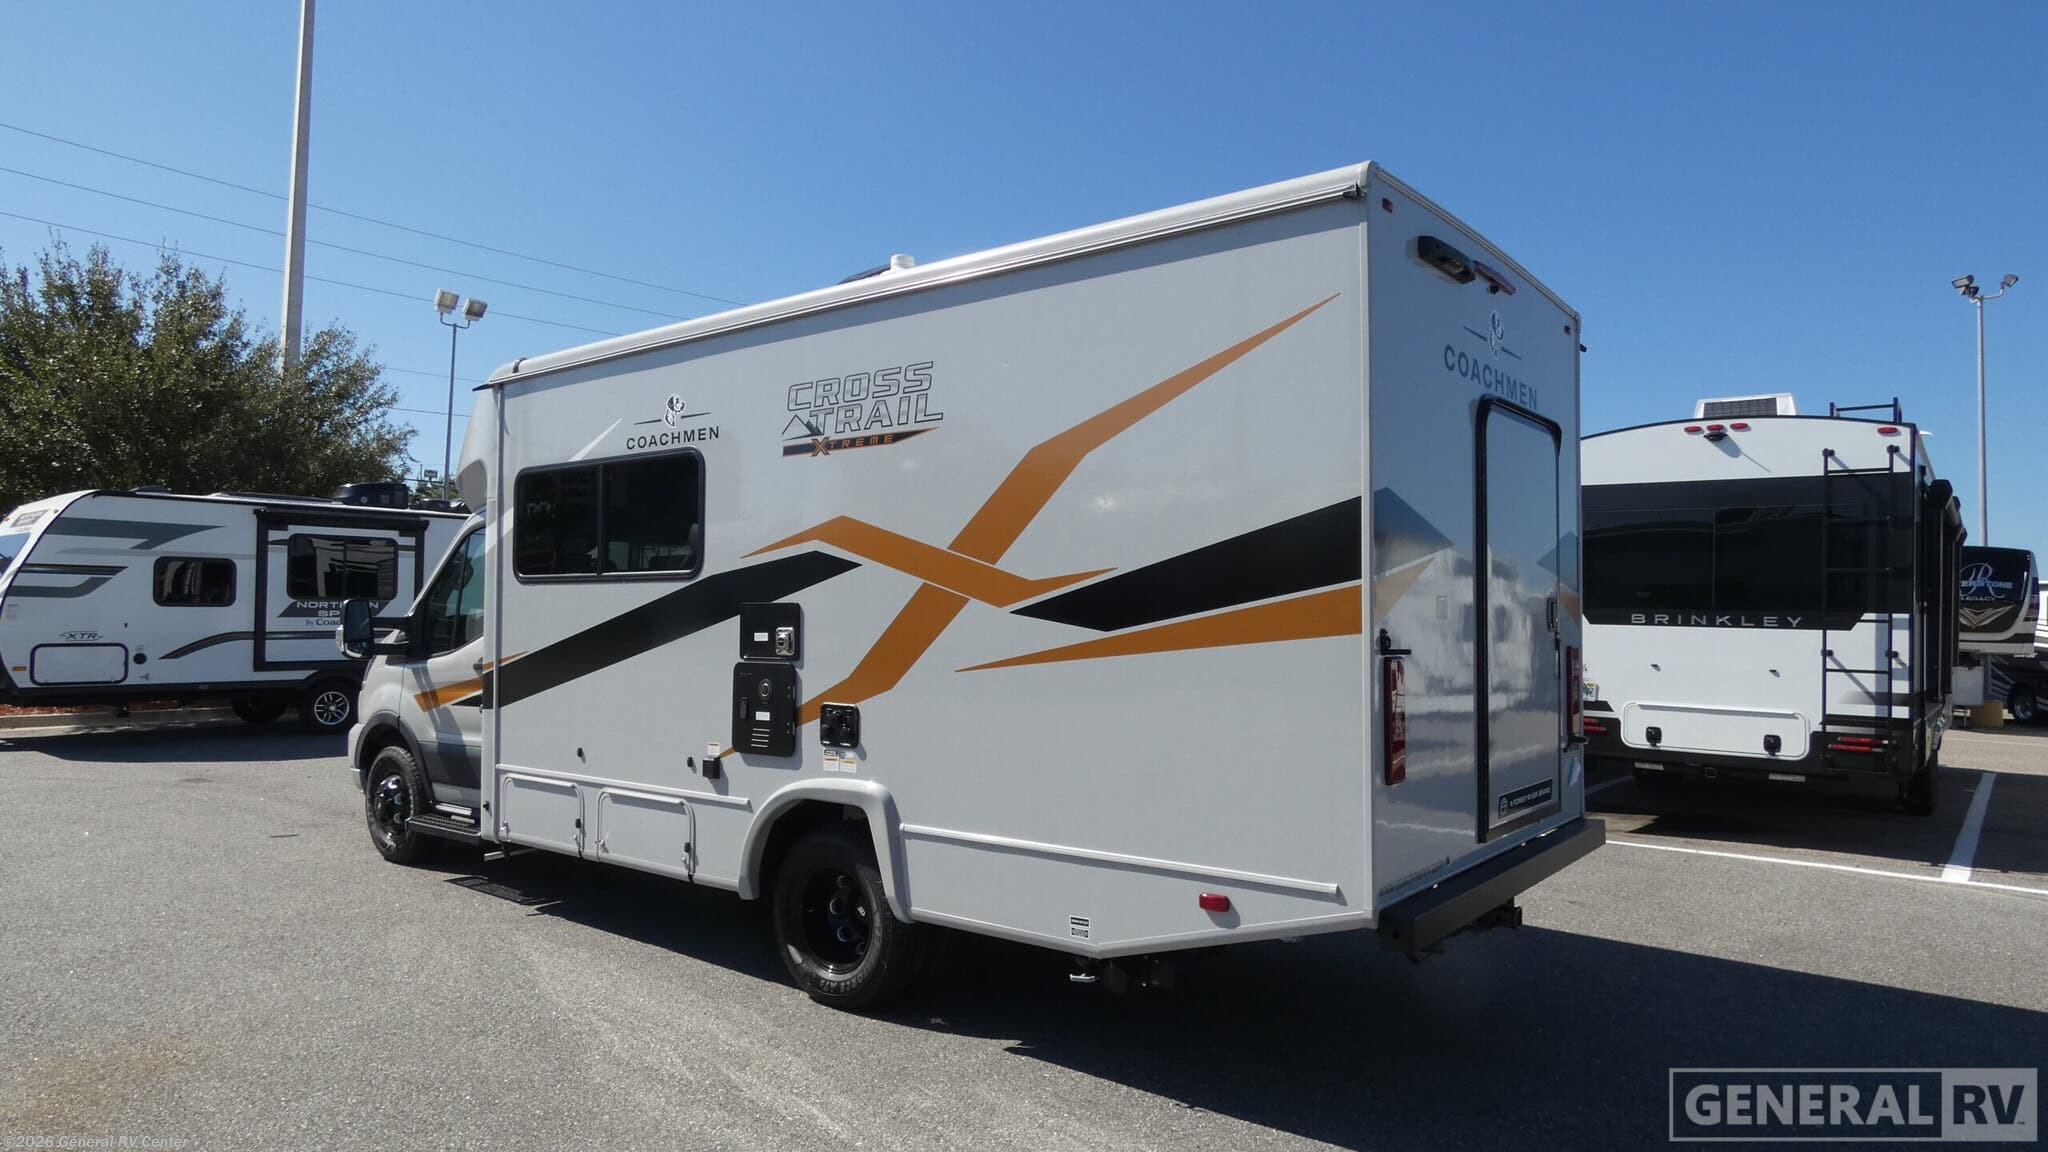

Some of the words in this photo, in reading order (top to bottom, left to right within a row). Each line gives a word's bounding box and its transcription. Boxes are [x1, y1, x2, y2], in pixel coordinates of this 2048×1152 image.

[787, 360, 934, 412] CROSS
[1444, 344, 1538, 410] COACHMEN
[809, 394, 944, 438] TRAIL
[626, 426, 720, 451] COACHMEN
[810, 434, 895, 458] XTREME
[1960, 576, 2014, 589] ERSTONE
[296, 601, 379, 609] NORTN
[1631, 613, 1804, 628] BRINKLEY
[66, 631, 99, 641] XTR
